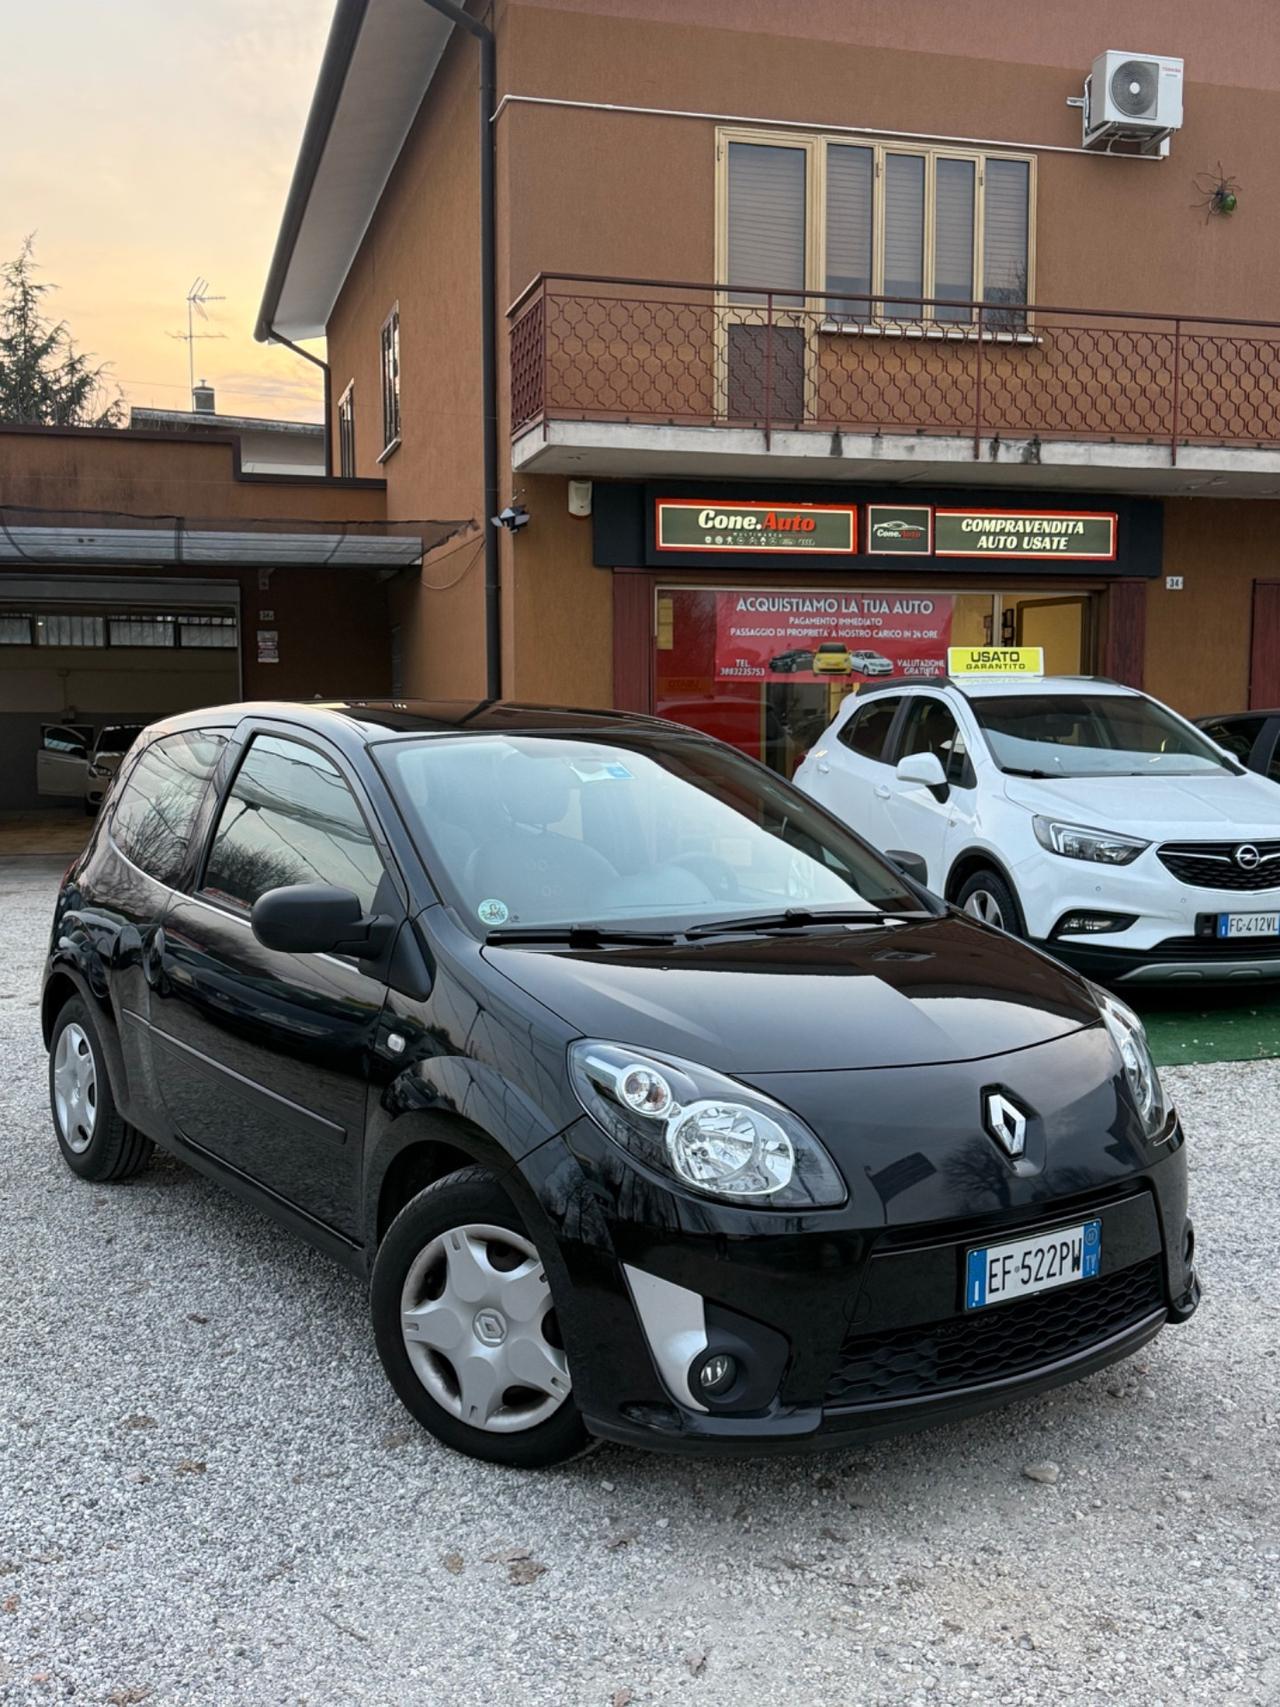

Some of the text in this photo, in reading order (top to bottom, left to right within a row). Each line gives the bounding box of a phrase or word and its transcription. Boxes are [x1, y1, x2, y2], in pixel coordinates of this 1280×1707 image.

[698, 509, 816, 532] Cone.Auto
[961, 519, 1085, 534] COMPRAVENDITA
[977, 536, 1068, 550] AUTO USATE
[736, 598, 933, 614] ACQUISTIAMO LA TUA AUTO
[789, 617, 883, 626] PAGAMENTO IMMEDIATO
[730, 628, 775, 637] PASSAGGIO
[777, 628, 785, 637] DI
[832, 629, 837, 638] A
[839, 629, 871, 638] NOSTRO
[873, 630, 902, 638] CARICO
[904, 630, 911, 638] IN
[923, 630, 938, 639] ORE
[971, 651, 1020, 662] USATO
[897, 659, 945, 667] VALUTAZIONE
